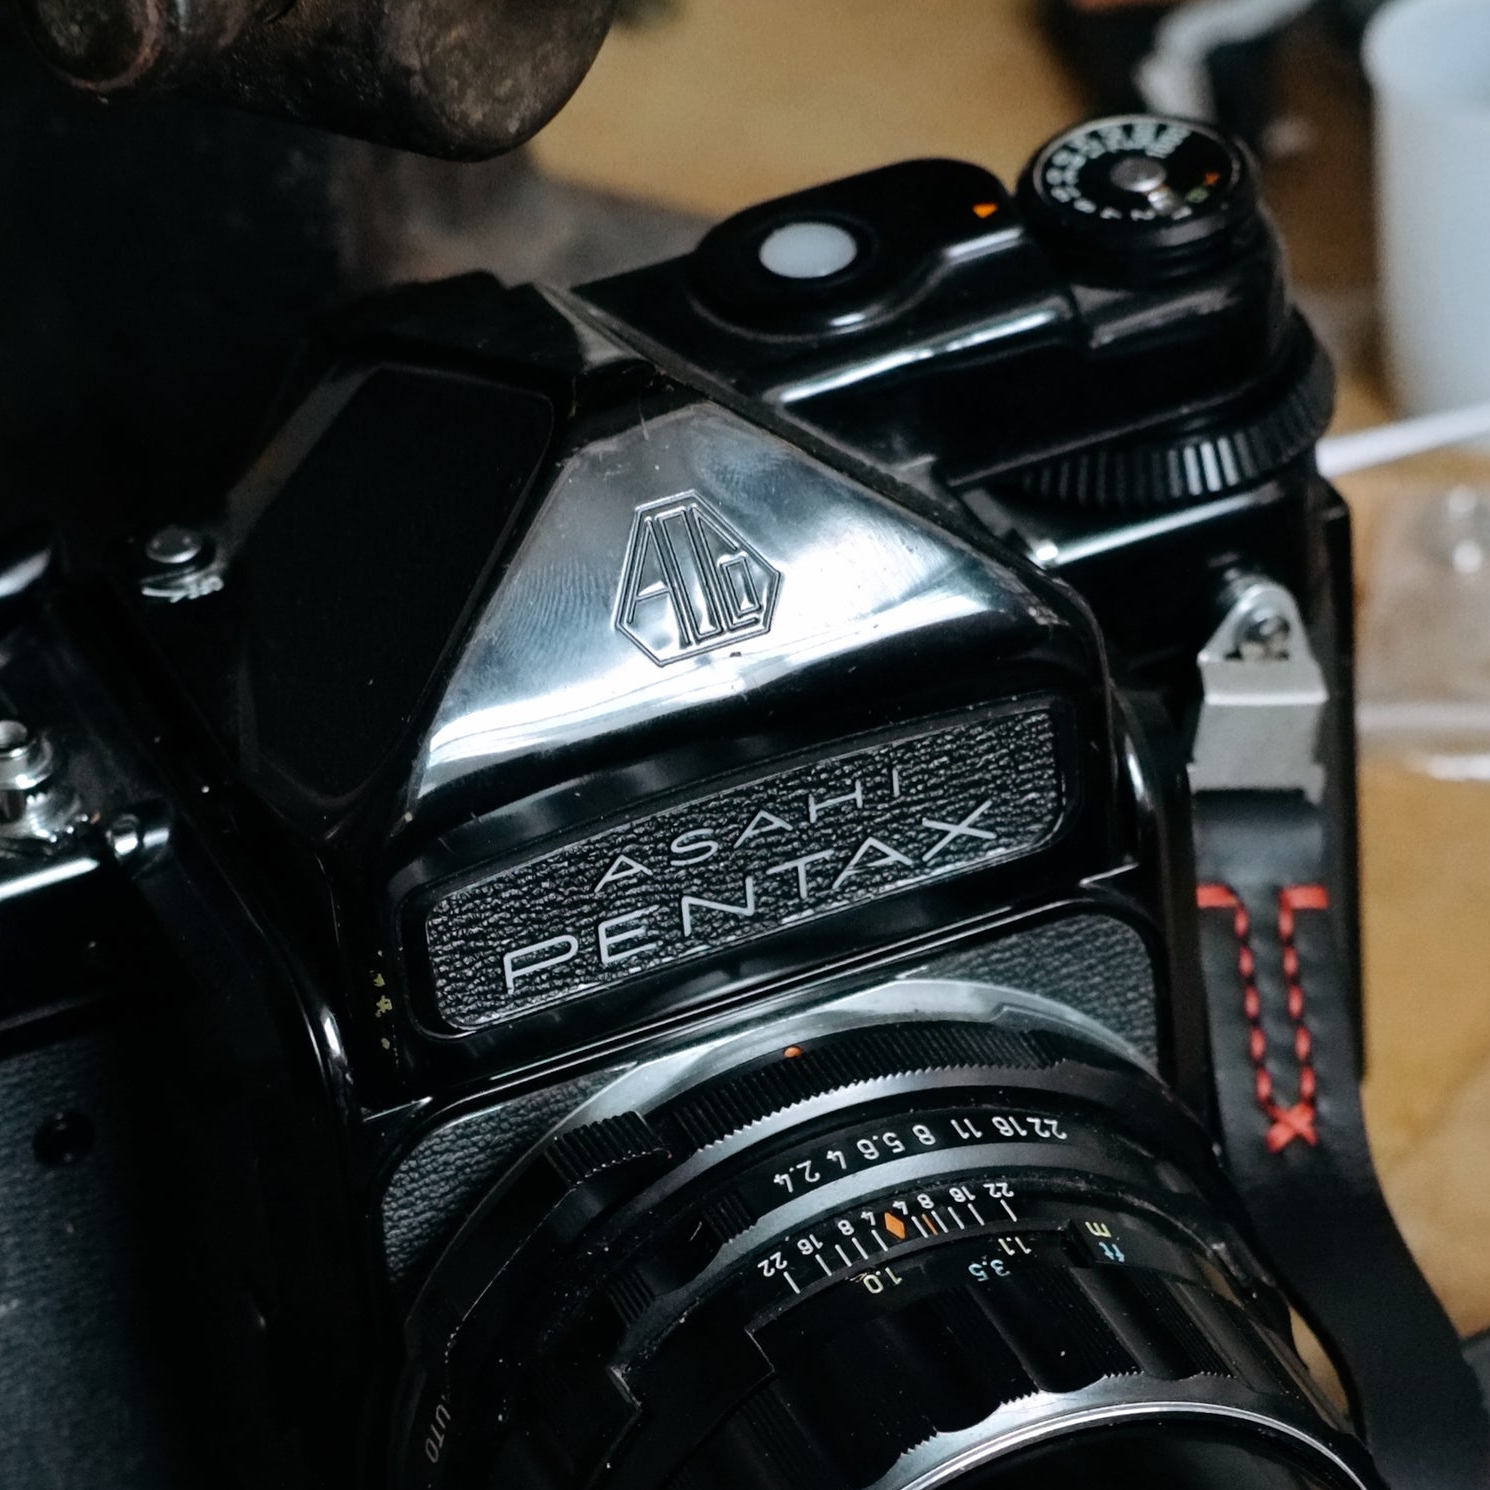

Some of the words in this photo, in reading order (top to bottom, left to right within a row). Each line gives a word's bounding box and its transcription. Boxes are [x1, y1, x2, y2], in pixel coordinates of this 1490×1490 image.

[594, 767, 901, 893] ASAHI
[502, 800, 997, 994] PENTAX
[912, 1124, 936, 1146] 8
[950, 1118, 983, 1140] 11
[991, 1116, 1028, 1137] 16
[1026, 1117, 1068, 1140] 22
[856, 1131, 906, 1160] 5.6
[826, 1150, 847, 1170] 4
[773, 1159, 821, 1193] 2.4
[982, 1181, 1015, 1198] 22
[892, 1200, 909, 1216] 4
[916, 1193, 935, 1209] 8
[837, 1219, 855, 1236] 8
[860, 1211, 876, 1226] 4
[796, 1233, 824, 1255] 16
[757, 1251, 788, 1277] 22
[968, 1258, 1011, 1282] 3.5
[858, 1266, 903, 1294] 1.0
[423, 1394, 453, 1464] UTO
